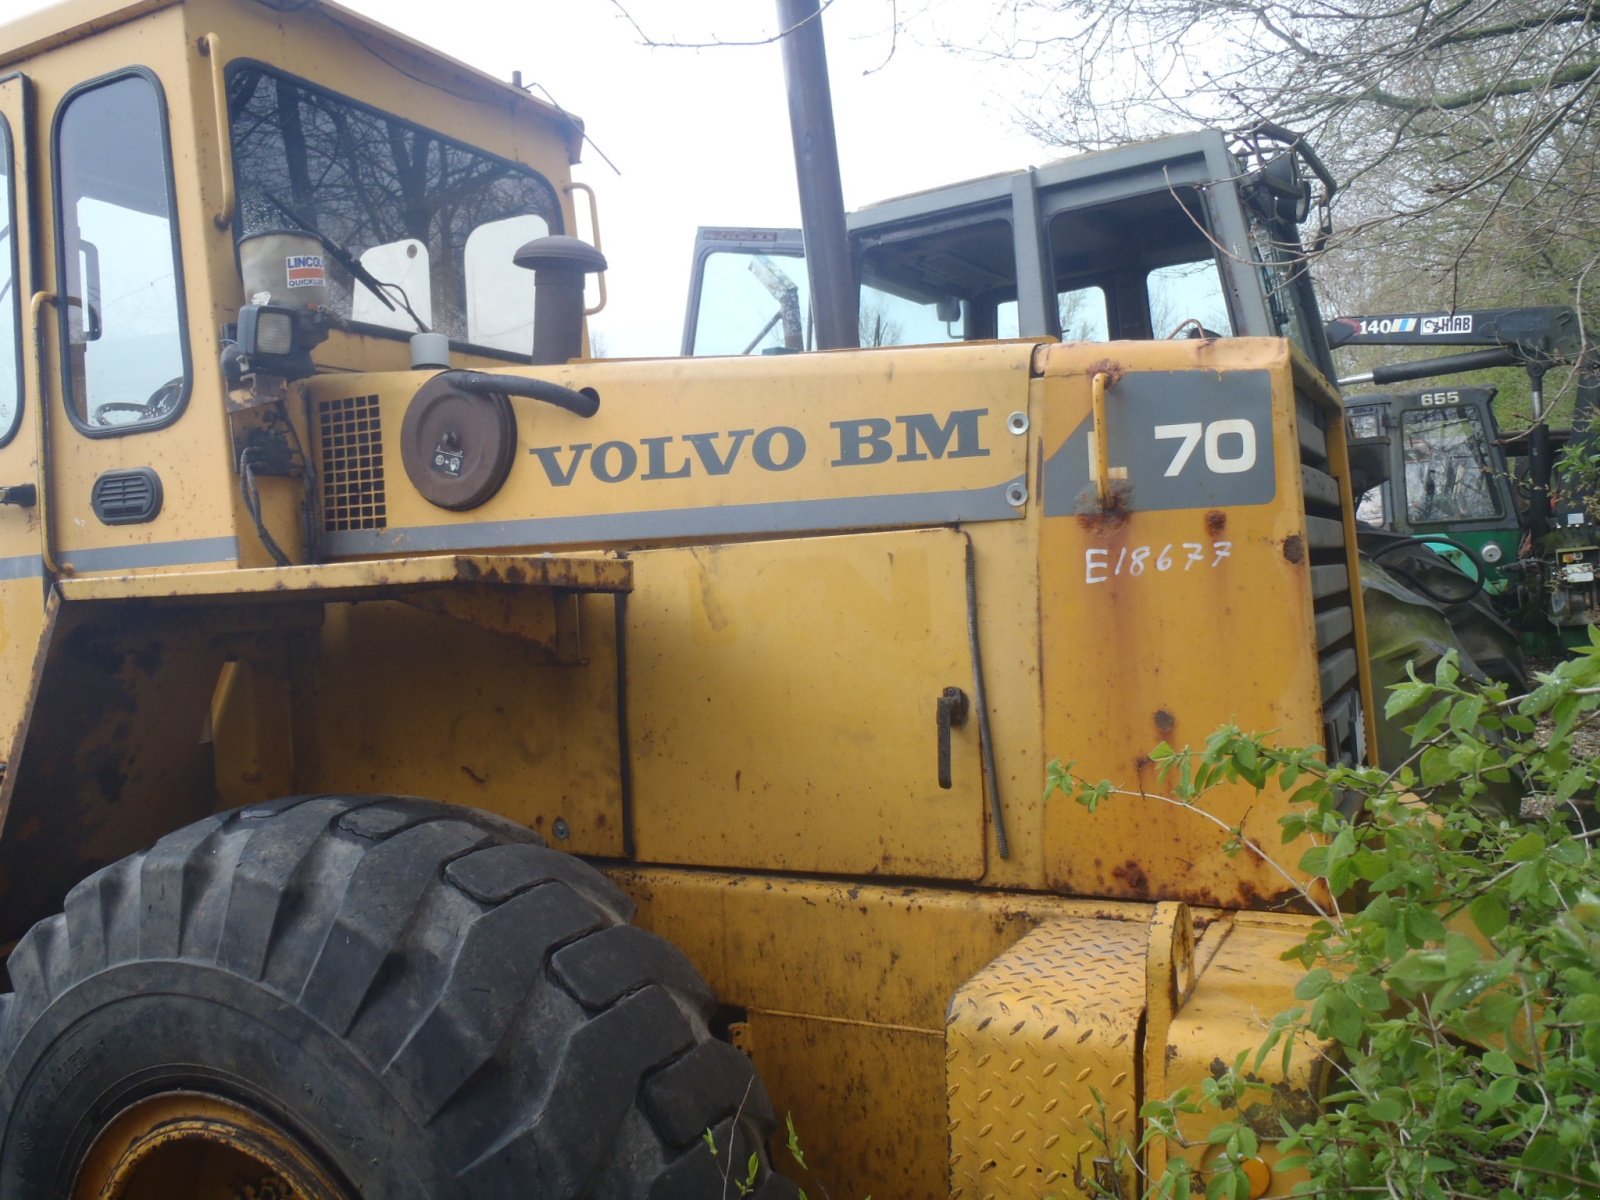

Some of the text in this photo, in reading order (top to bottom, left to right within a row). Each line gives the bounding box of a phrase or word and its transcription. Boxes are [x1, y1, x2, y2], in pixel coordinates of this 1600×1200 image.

[1360, 319, 1392, 335] 140
[1441, 317, 1471, 333] HIAB
[1421, 391, 1459, 406] 655
[529, 408, 990, 487] VOLVO BM
[1154, 418, 1257, 478] 70
[1085, 541, 1232, 584] E18677
